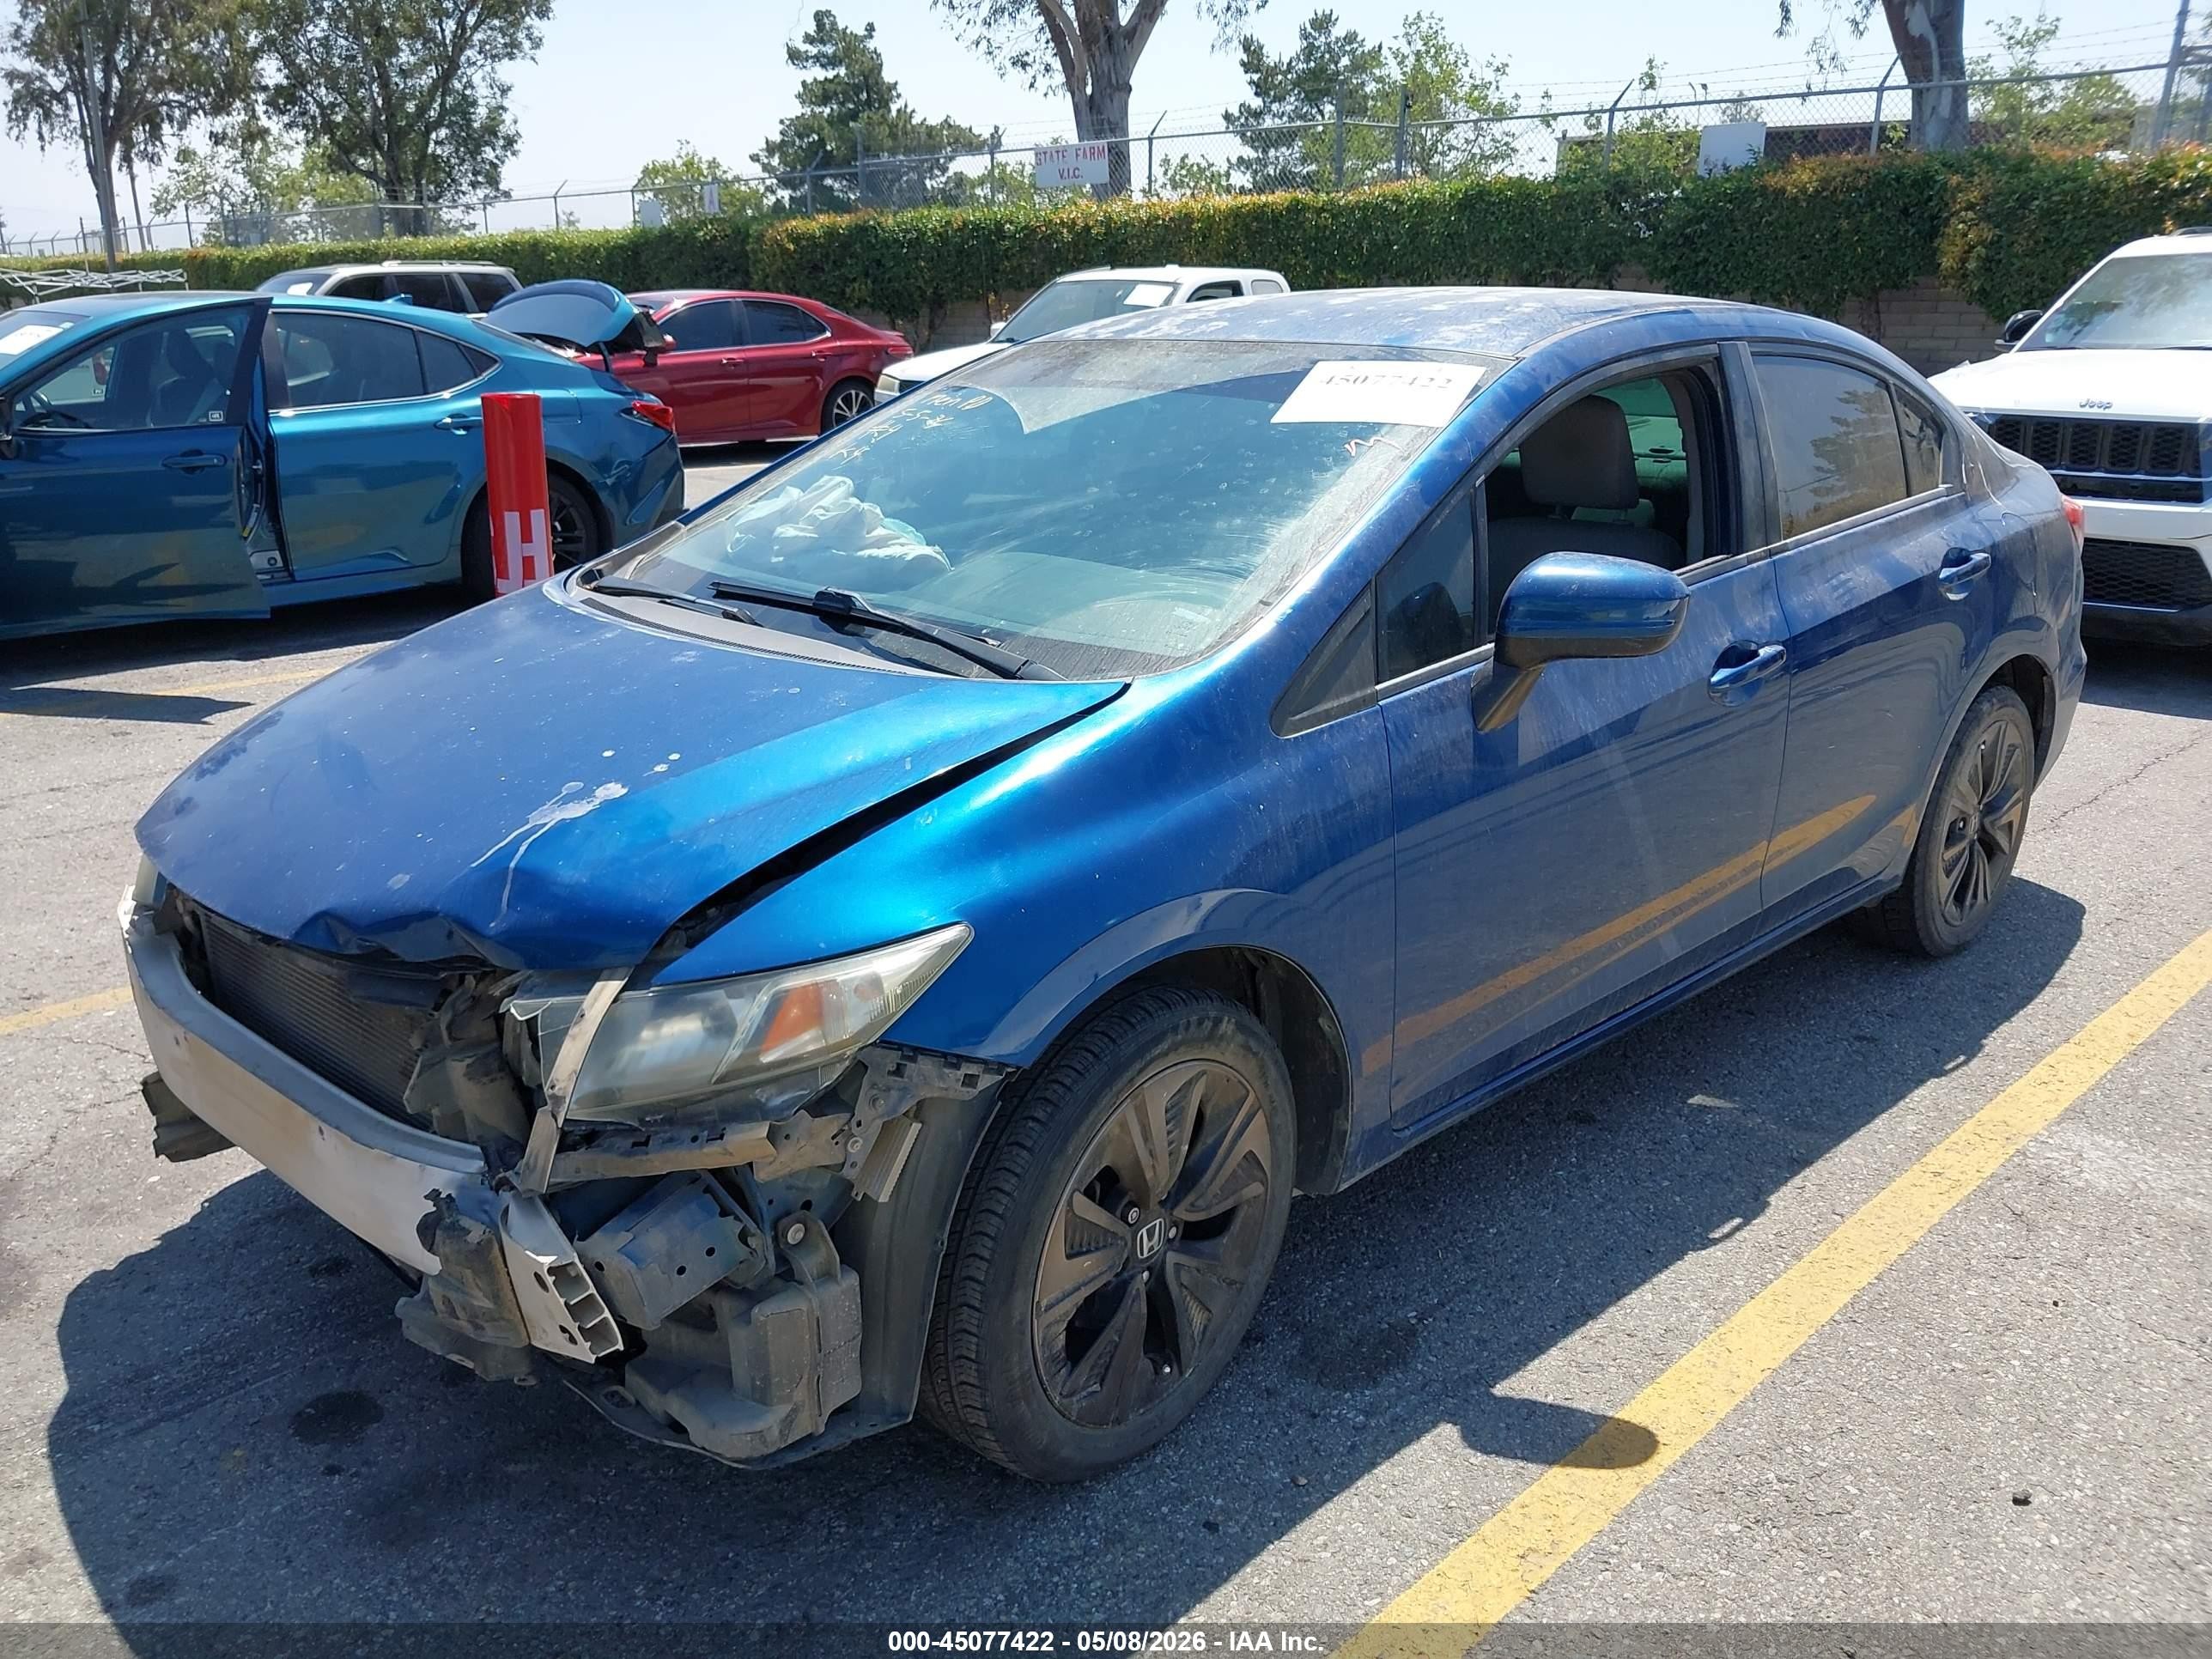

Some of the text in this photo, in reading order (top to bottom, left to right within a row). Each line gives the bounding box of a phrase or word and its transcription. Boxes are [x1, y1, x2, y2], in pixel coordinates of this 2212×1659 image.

[1036, 145, 1106, 166] STATE FARM
[1059, 167, 1084, 180] V.I.C.
[2079, 398, 2113, 411] Jeep
